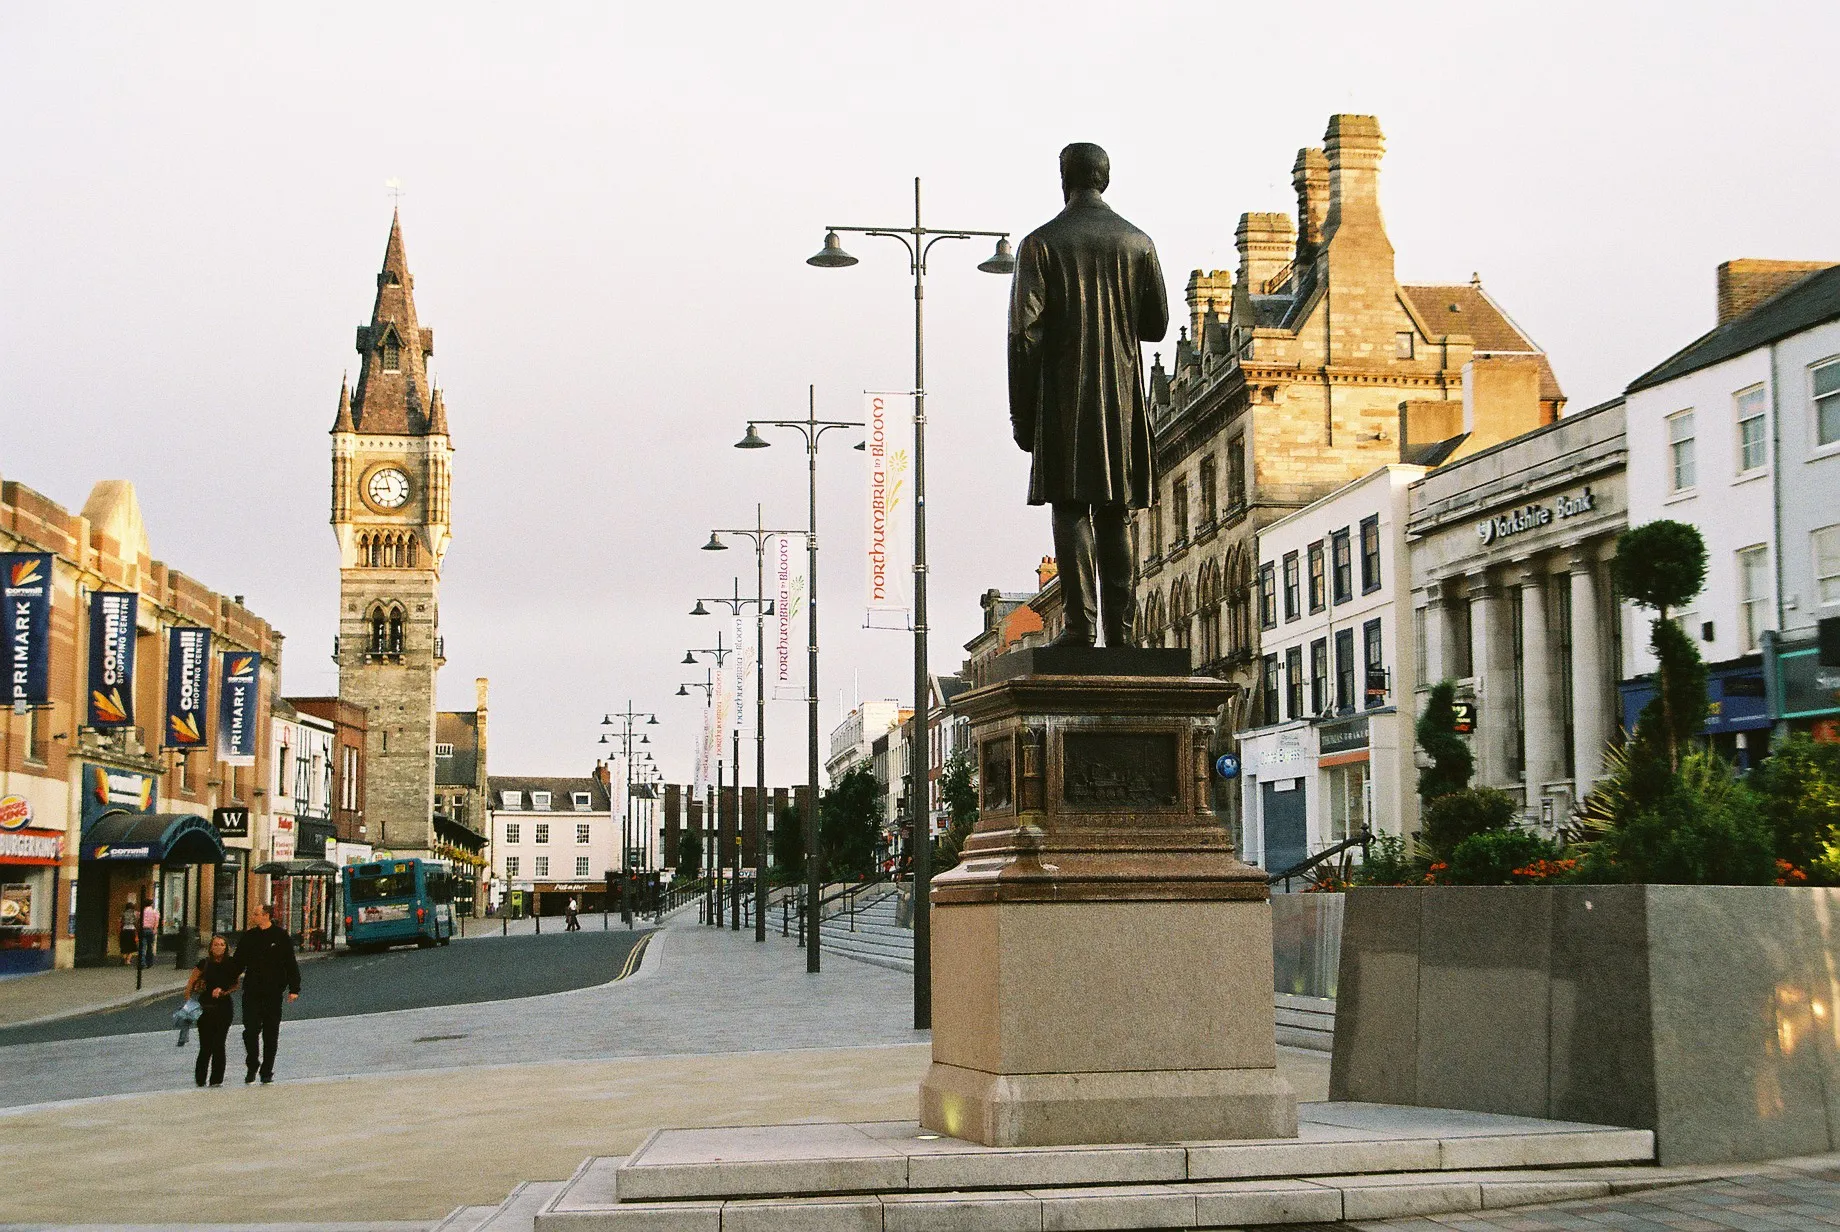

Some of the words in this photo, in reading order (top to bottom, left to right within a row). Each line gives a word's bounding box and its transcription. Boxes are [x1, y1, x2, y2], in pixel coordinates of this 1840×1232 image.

[1495, 505, 1551, 538] Yorkshire
[1556, 486, 1595, 519] Bank
[119, 597, 129, 634] CENTRE
[13, 601, 31, 698] PRIMARK
[103, 596, 121, 685] cornmill
[117, 637, 126, 684] SHOPPING
[195, 632, 204, 666] CENTRE
[180, 631, 197, 711] cornmill
[193, 667, 202, 710] SHOPPING
[231, 686, 245, 755] PRIMARK
[222, 812, 243, 828] W
[110, 847, 149, 855] cornmill
